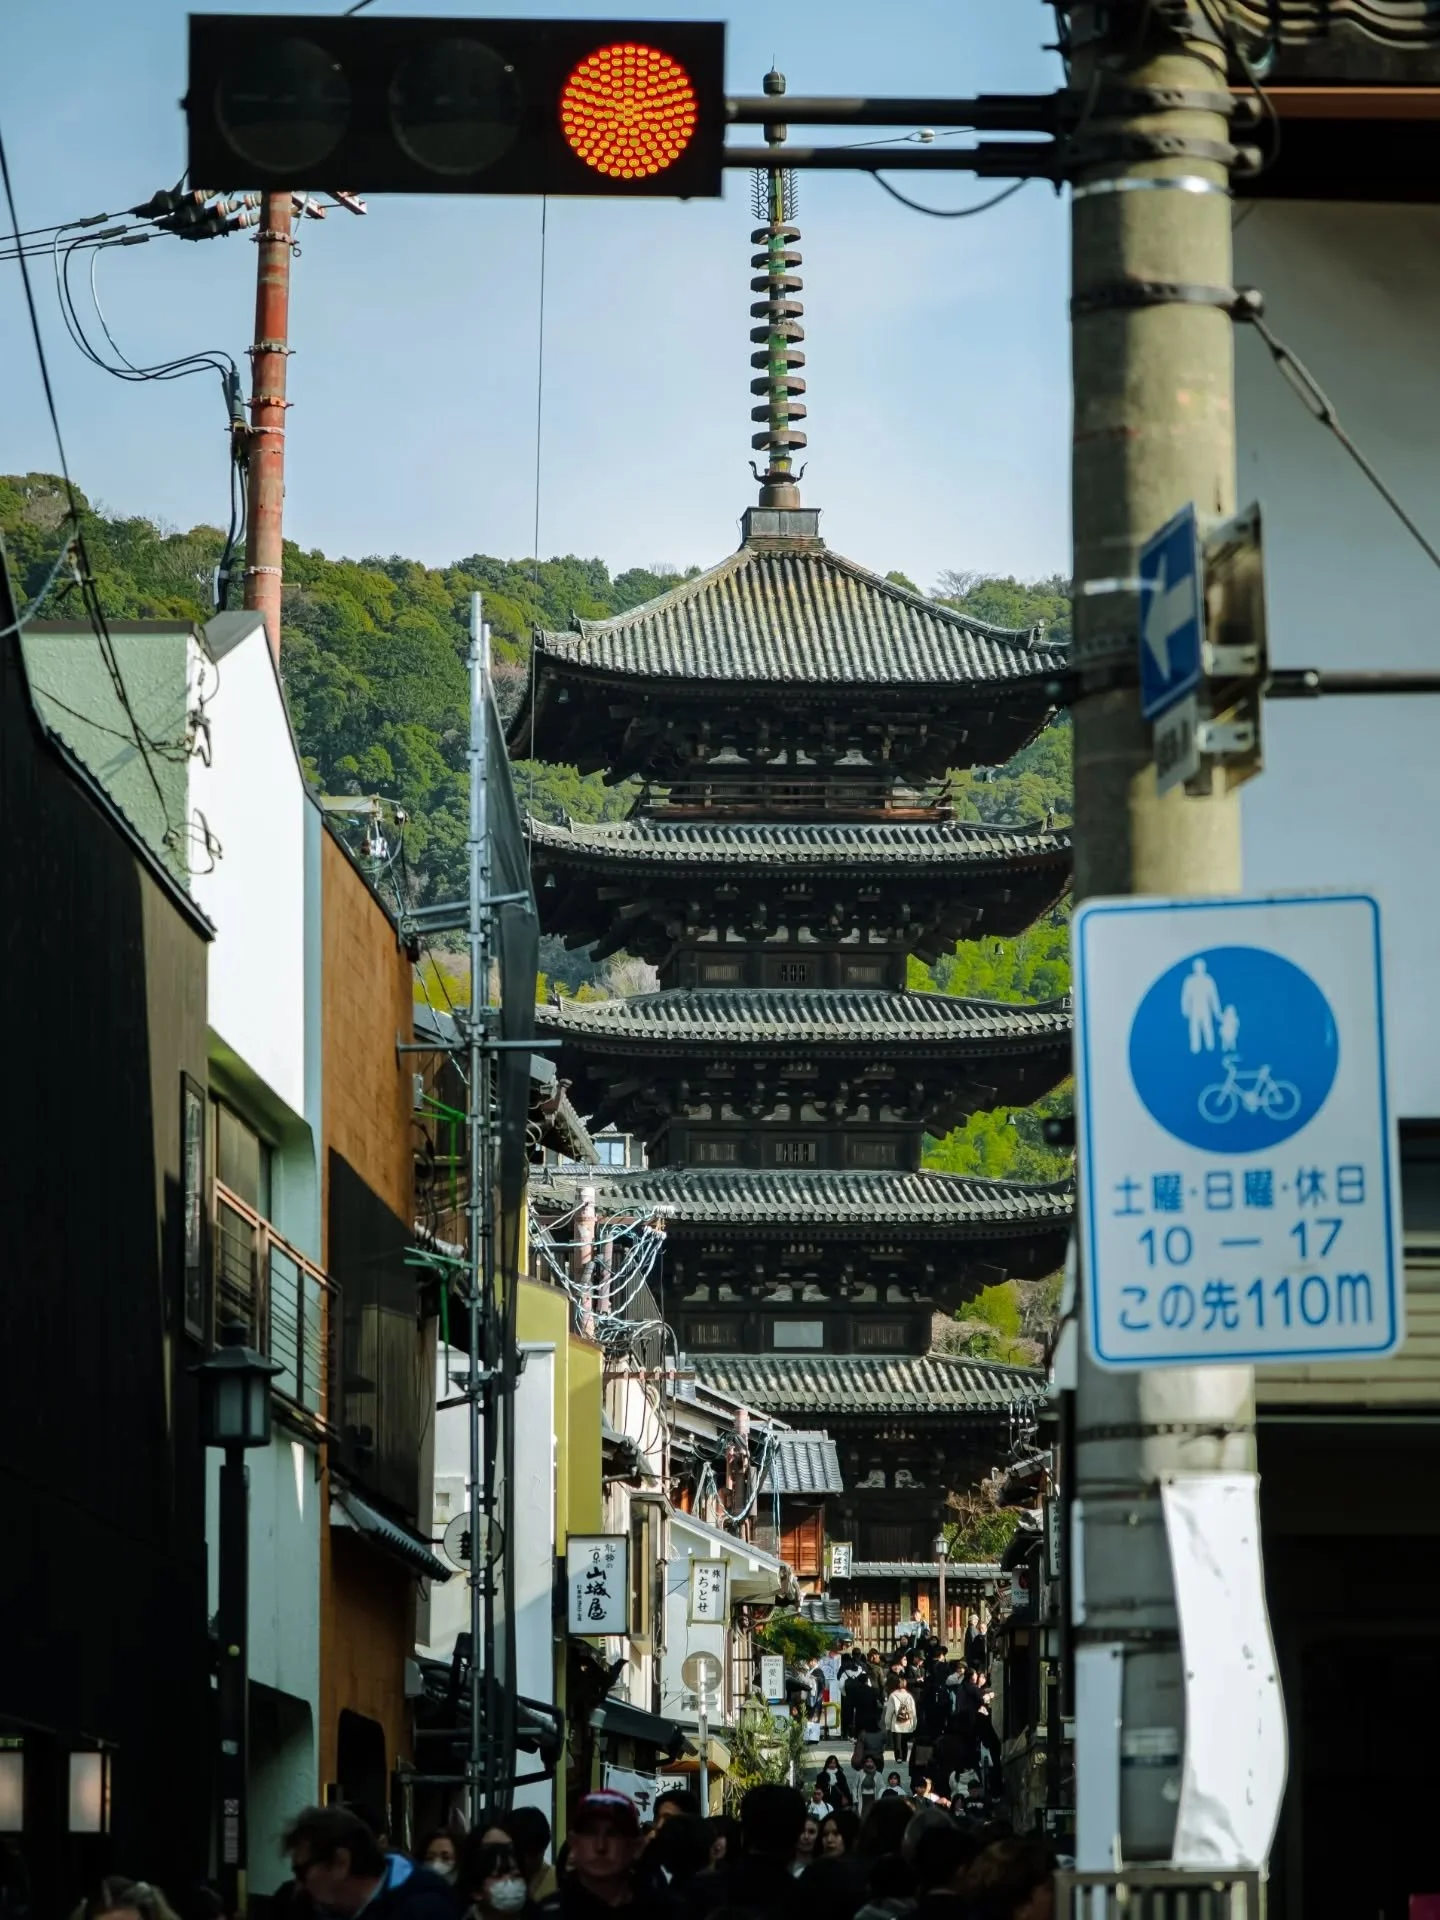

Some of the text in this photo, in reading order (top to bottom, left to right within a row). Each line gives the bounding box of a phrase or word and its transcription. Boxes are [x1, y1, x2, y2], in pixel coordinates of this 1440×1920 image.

[1113, 1165, 1365, 1217] 土曜・日曜・休日
[1138, 1224, 1194, 1268] 10
[1289, 1217, 1343, 1259] 17
[1119, 1273, 1374, 1331] この先110m
[697, 1576, 709, 1613] ちとせ
